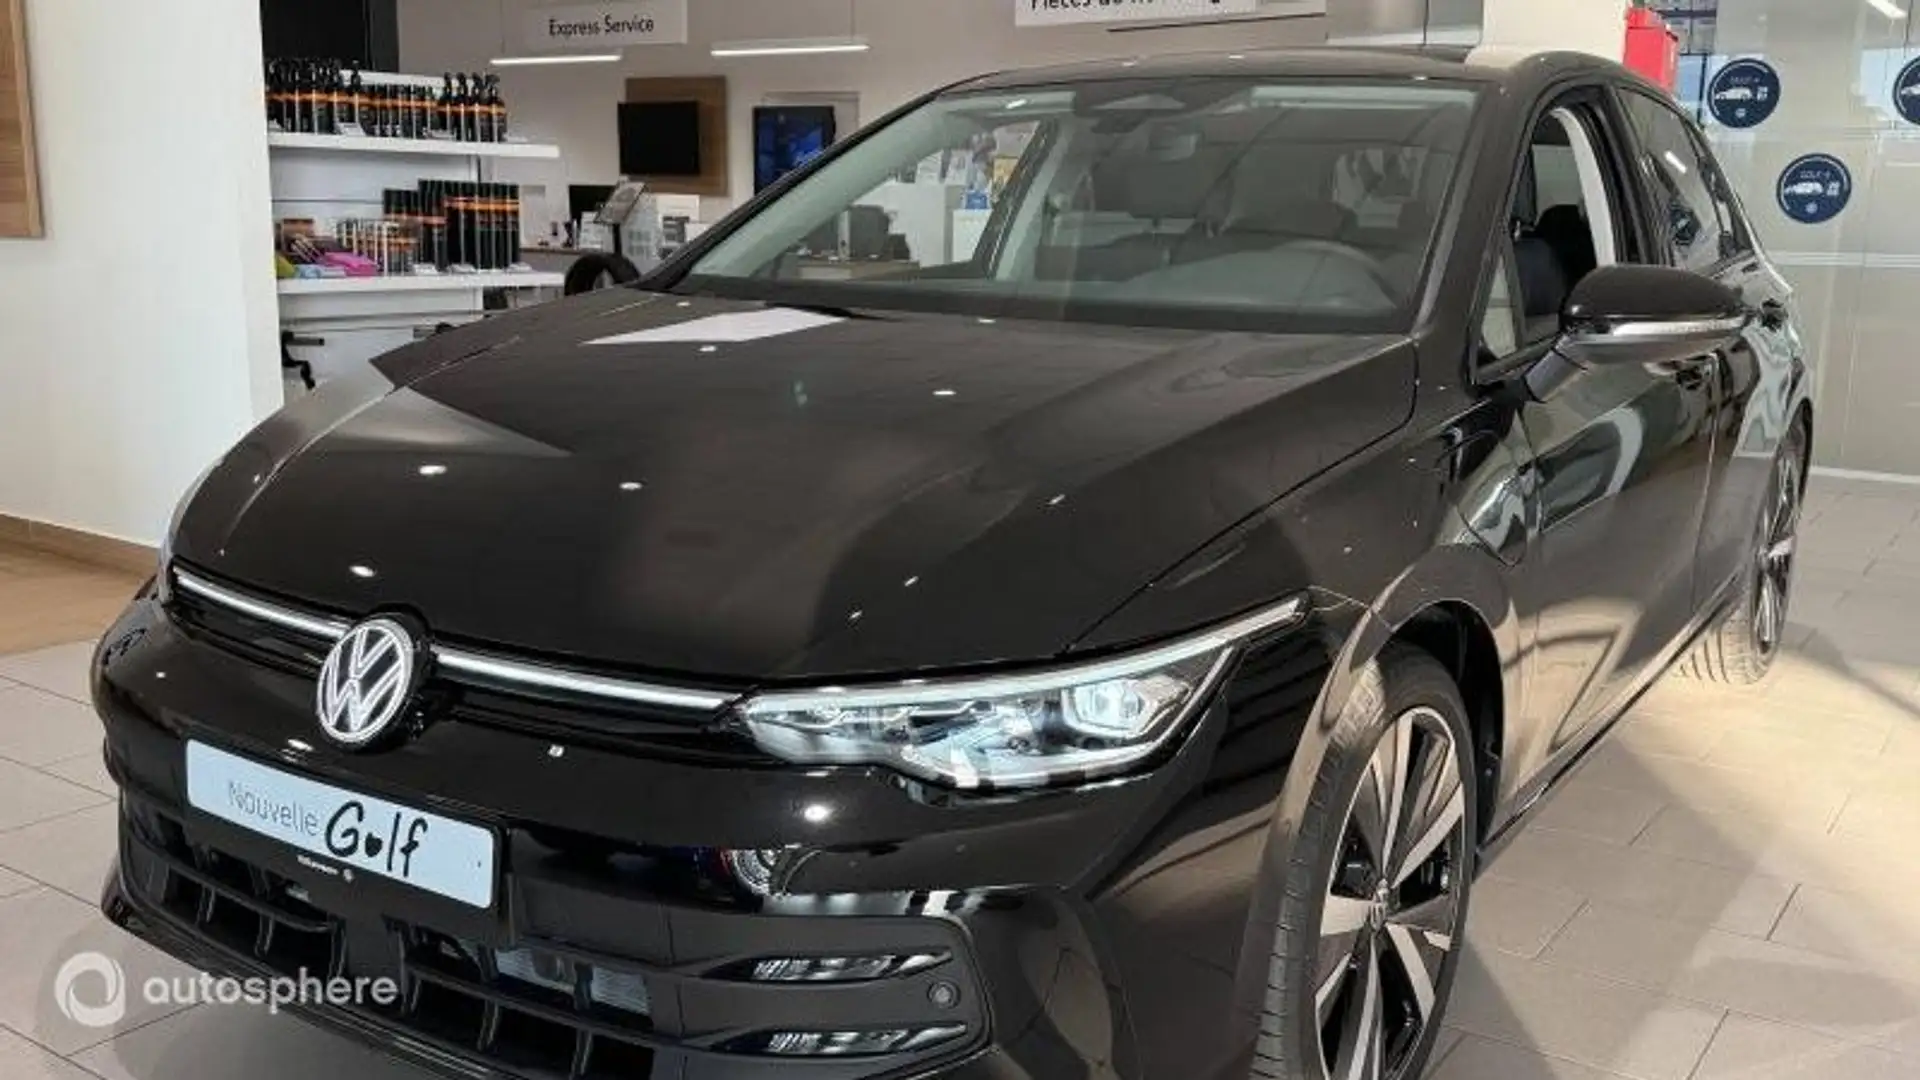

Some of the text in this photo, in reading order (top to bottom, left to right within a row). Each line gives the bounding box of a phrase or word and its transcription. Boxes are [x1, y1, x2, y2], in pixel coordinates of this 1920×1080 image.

[549, 14, 654, 38] Express Service
[228, 780, 319, 836] Nouvelle
